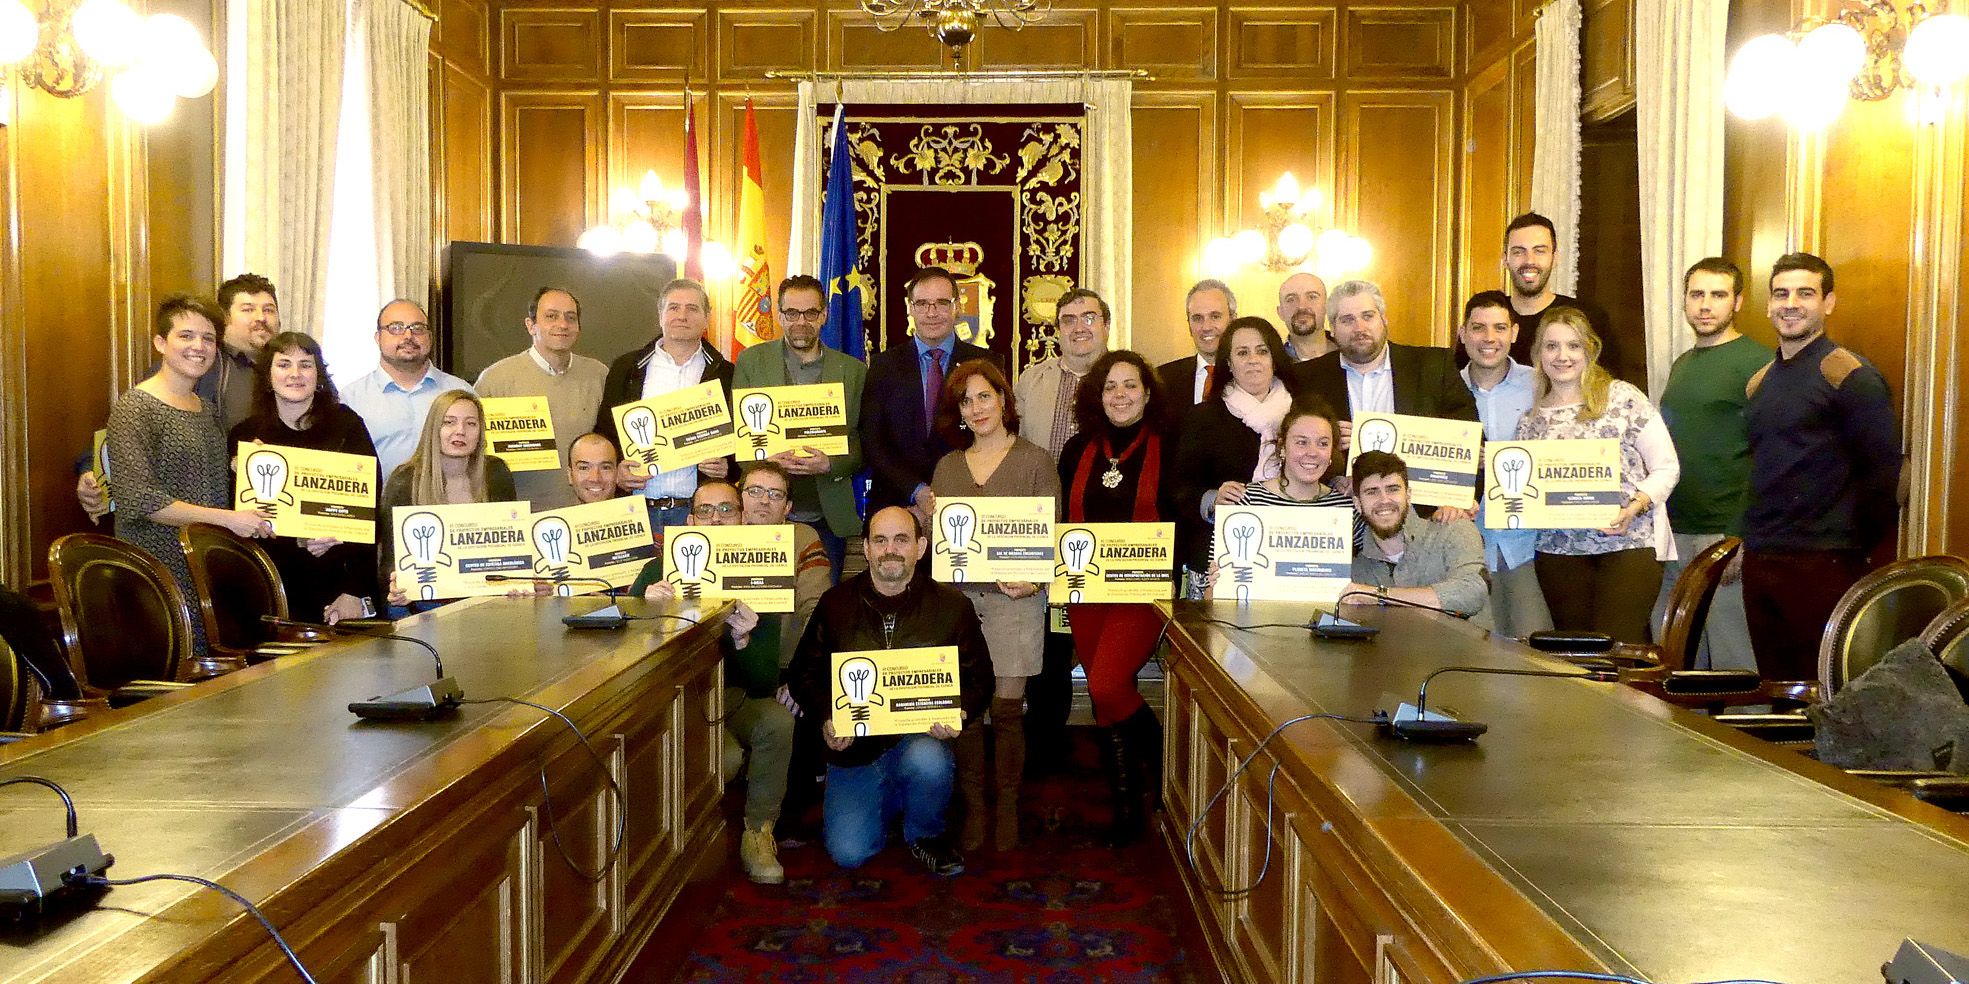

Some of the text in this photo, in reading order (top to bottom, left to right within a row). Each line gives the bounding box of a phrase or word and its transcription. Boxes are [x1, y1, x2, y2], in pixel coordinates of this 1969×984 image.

[661, 404, 722, 428] LANZADERA
[779, 406, 839, 418] LANZADERA
[1401, 442, 1471, 460] LANZADERA
[1538, 467, 1612, 479] LANZADERA
[294, 476, 368, 494] LANZADERA
[577, 522, 644, 544] LANZADERA
[981, 523, 1048, 534] LANZADERA
[450, 530, 525, 545] LANZADERA
[1269, 536, 1344, 549] LANZADERA
[716, 552, 787, 564] LANZADERA
[1100, 547, 1167, 558] LANZADERA
[882, 672, 953, 687] LANZADERA
